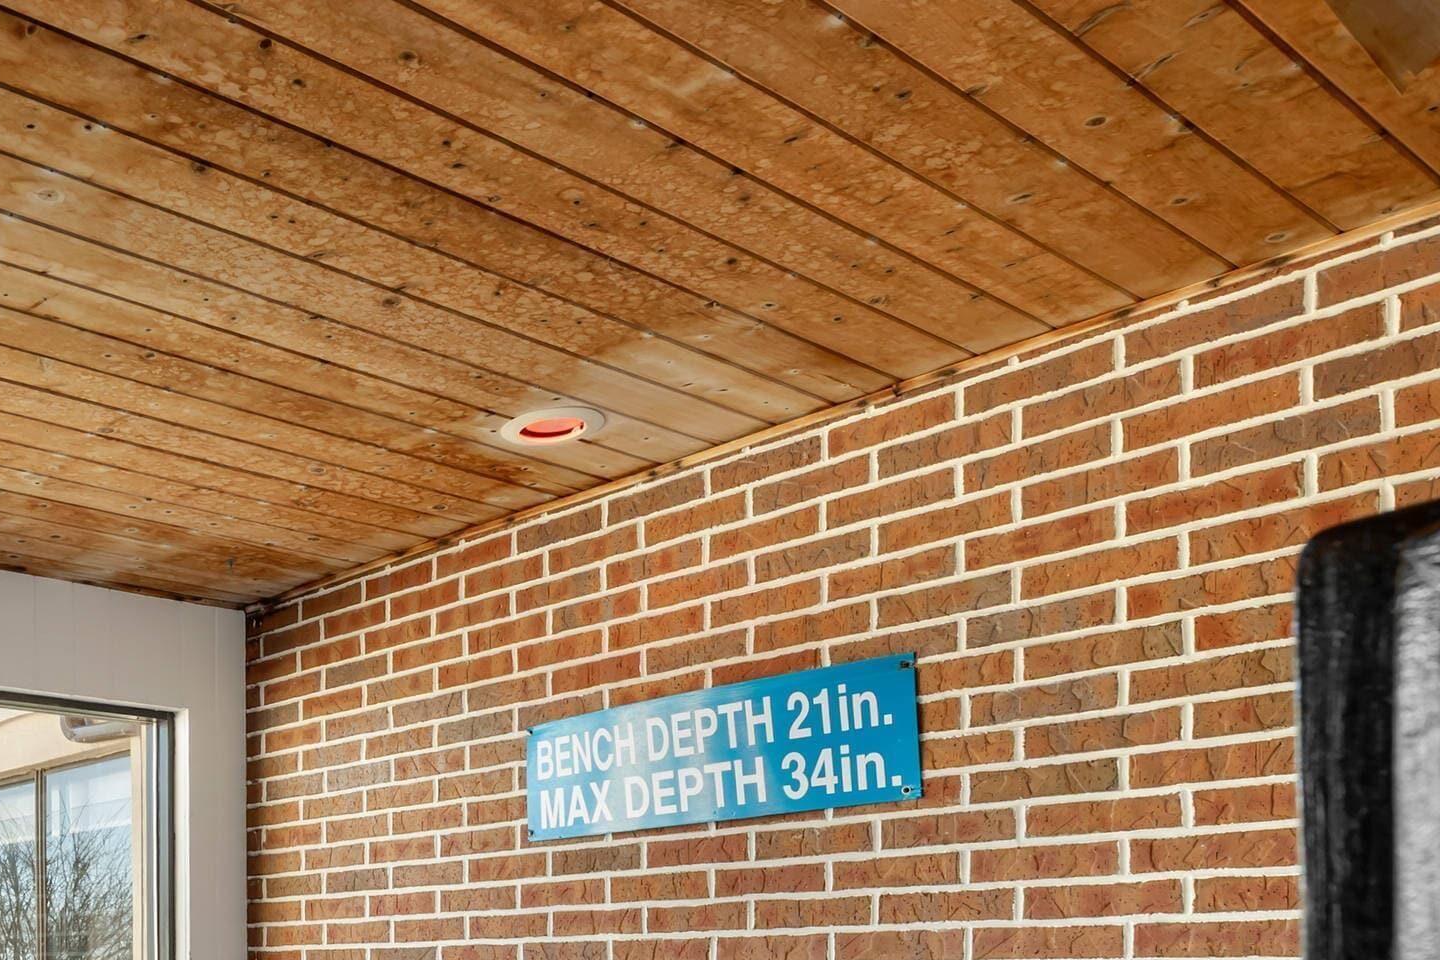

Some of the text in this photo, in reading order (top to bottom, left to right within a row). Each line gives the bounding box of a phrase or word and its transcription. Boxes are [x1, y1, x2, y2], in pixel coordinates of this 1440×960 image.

[536, 683, 893, 781] BENCH DEPTH 21in.
[540, 744, 903, 830] MAX DEPTH 34in.
